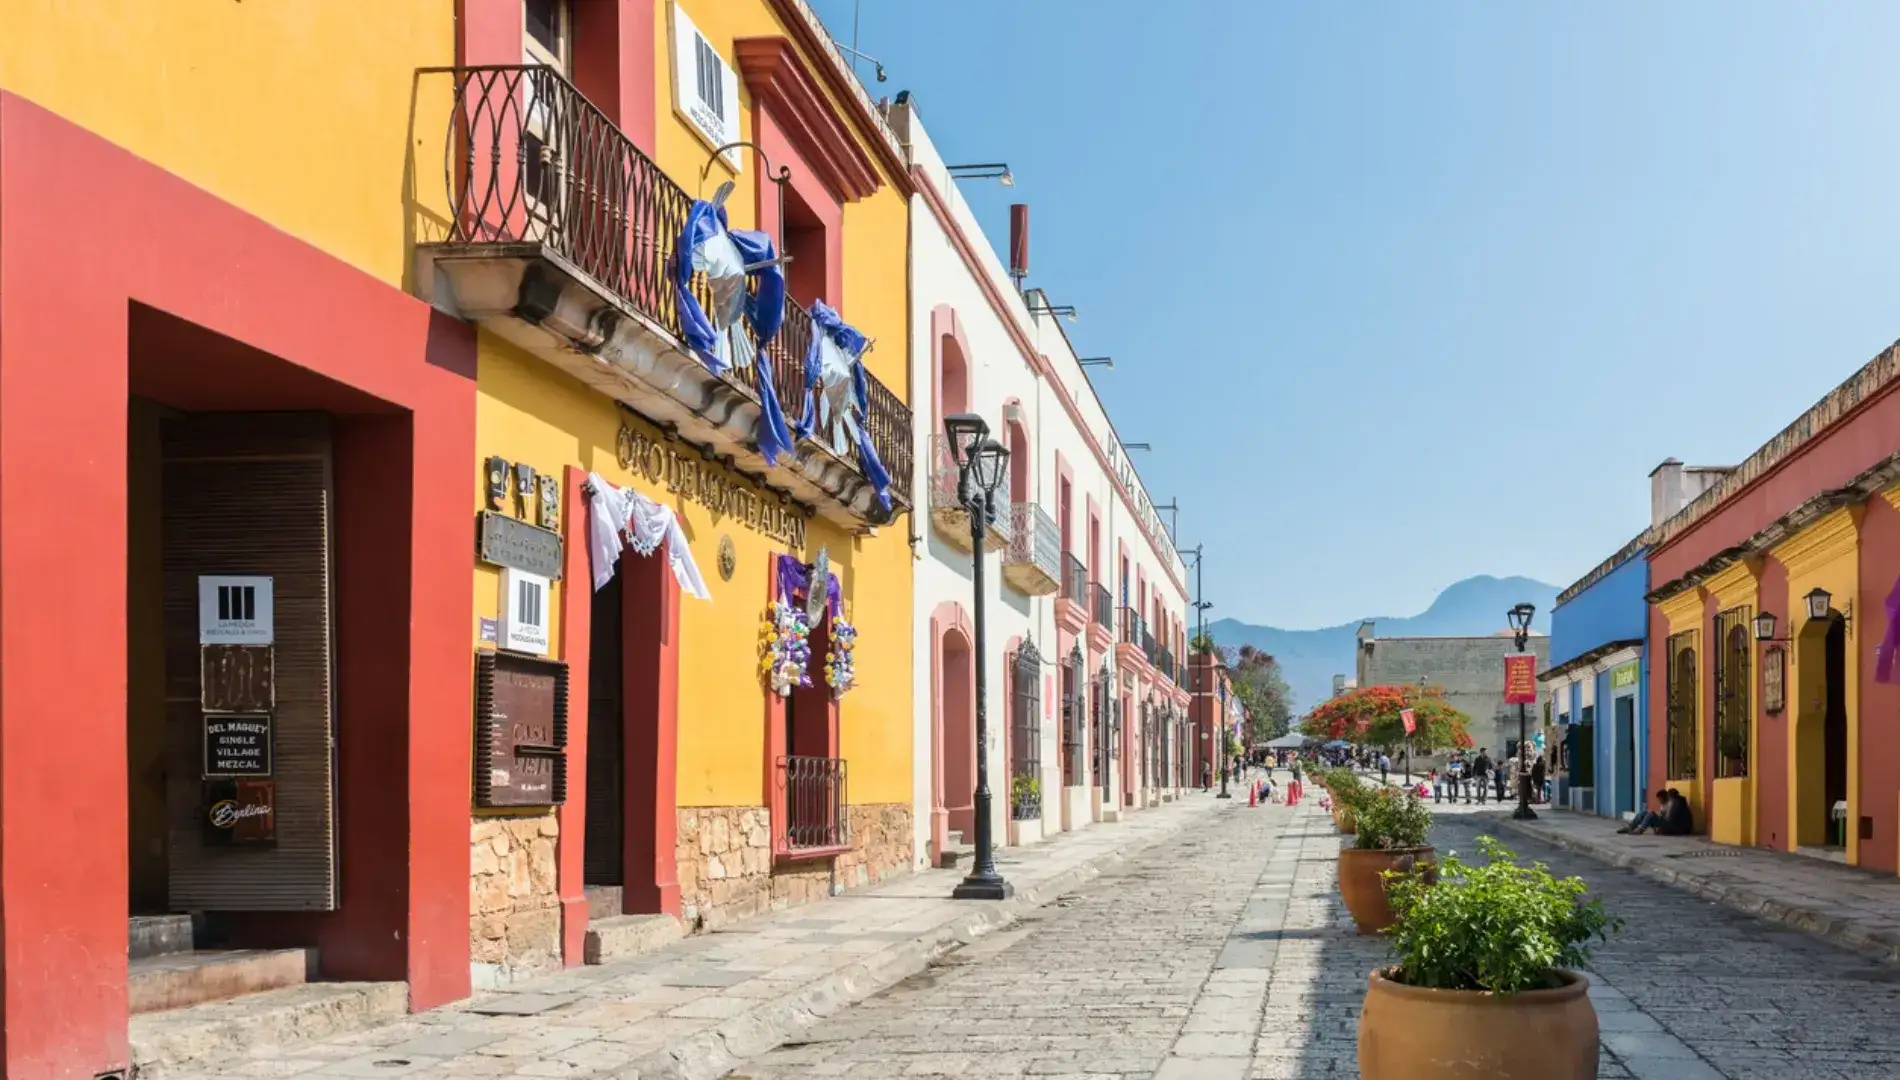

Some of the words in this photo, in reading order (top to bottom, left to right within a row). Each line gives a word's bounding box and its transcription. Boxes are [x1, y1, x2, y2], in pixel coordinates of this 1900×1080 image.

[667, 450, 697, 500] DE
[698, 468, 758, 530] MONTE
[208, 724, 226, 734] DEL
[228, 723, 268, 734] MAGUEY
[219, 736, 256, 744] SINGLE
[217, 748, 261, 756] VILLAGE
[217, 760, 260, 769] MEZCAL
[214, 803, 272, 826] Berlina
